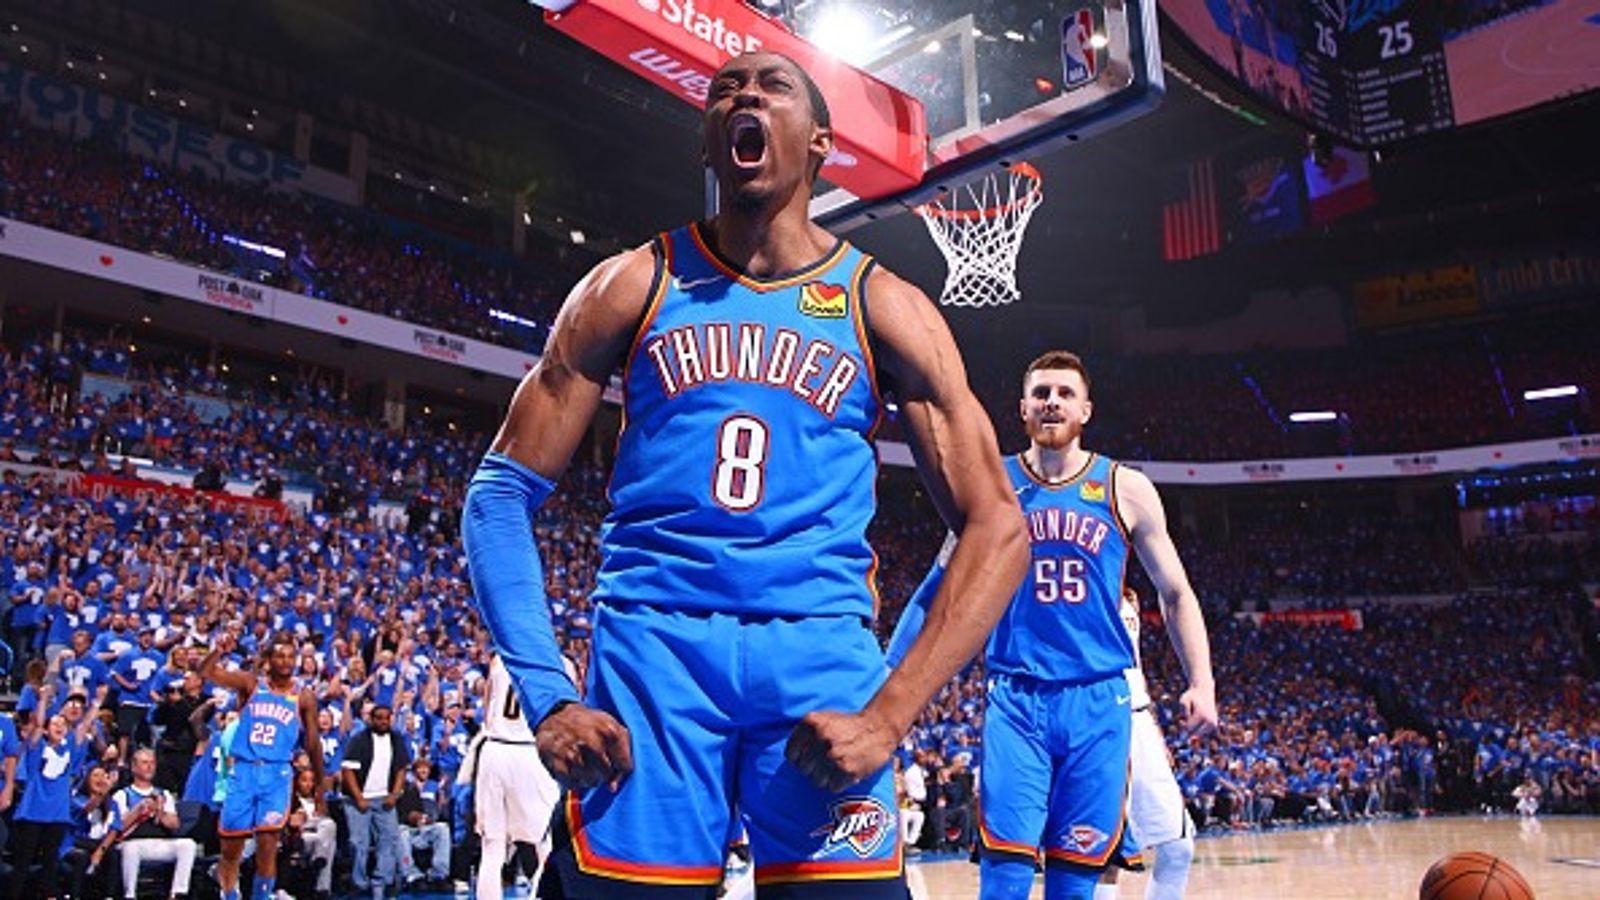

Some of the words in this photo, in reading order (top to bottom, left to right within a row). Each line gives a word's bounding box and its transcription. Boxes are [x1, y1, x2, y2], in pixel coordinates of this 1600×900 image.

[1313, 20, 1338, 59] 26
[1377, 20, 1415, 59] 25
[648, 322, 858, 420] THUNDER
[711, 414, 769, 512] 8
[1028, 508, 1108, 554] UNDER
[1033, 557, 1086, 604] 55
[250, 722, 277, 745] 22
